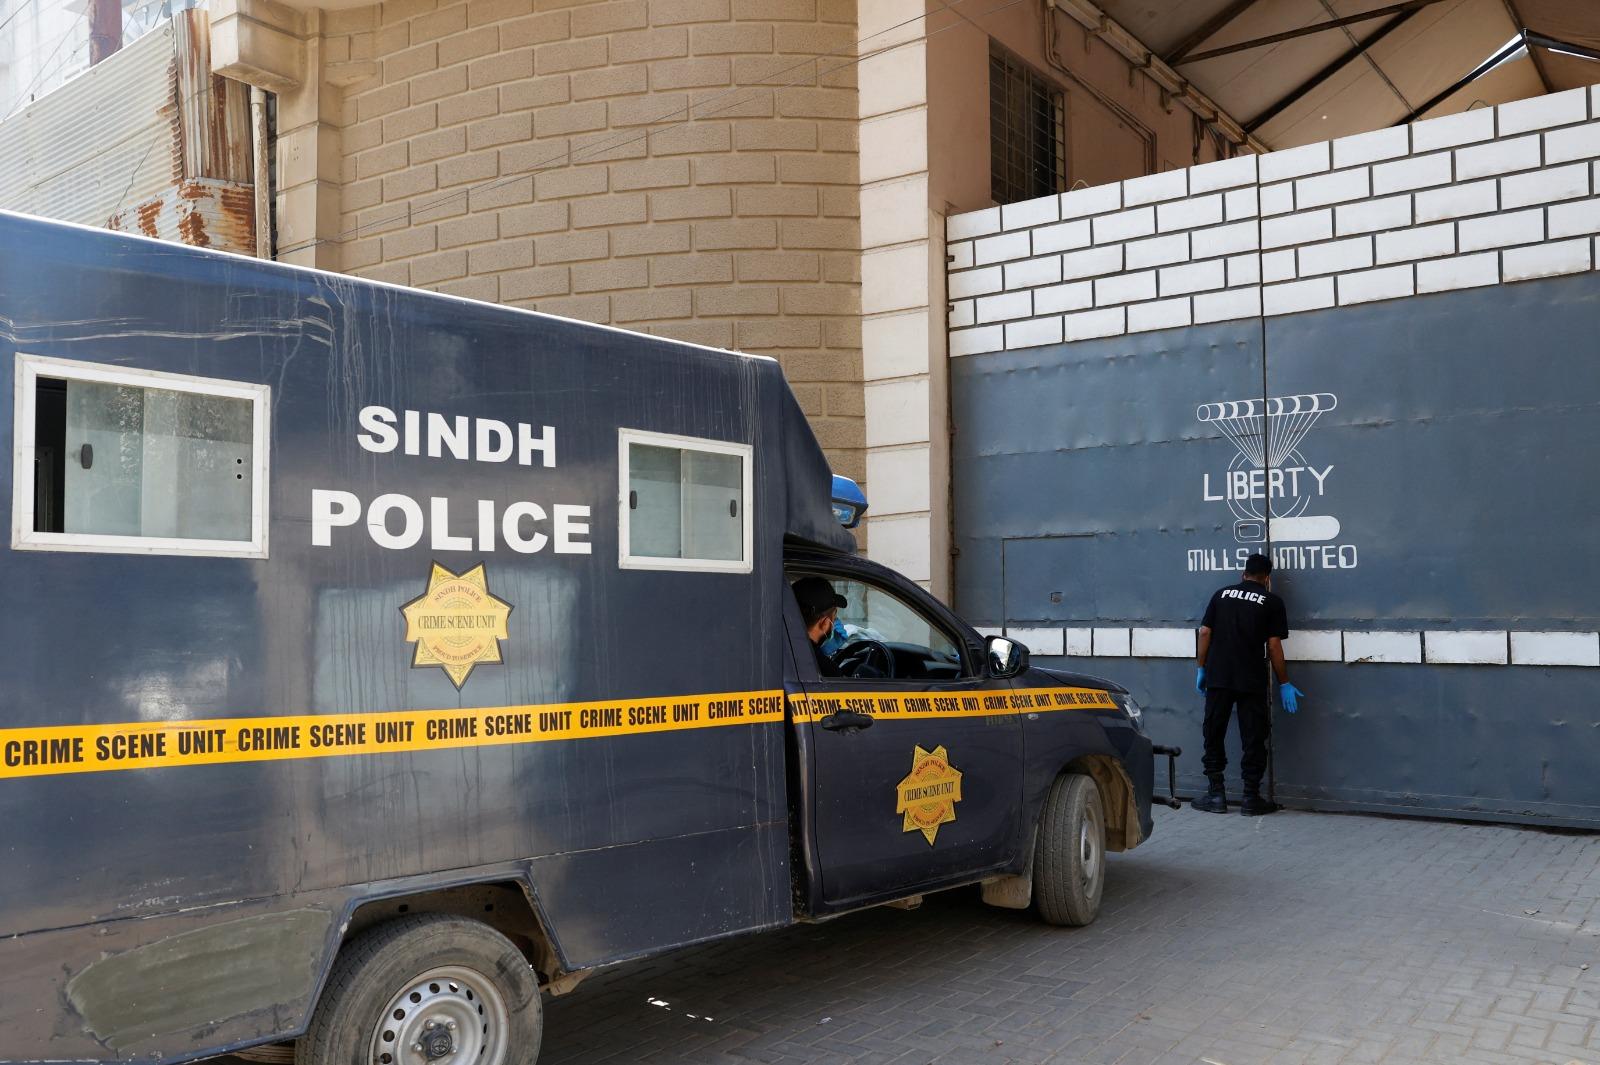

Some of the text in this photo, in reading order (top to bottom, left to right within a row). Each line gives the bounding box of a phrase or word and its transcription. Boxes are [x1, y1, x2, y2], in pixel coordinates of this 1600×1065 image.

[357, 406, 556, 467] SINDH
[1203, 464, 1334, 501] LIBERTY
[312, 489, 592, 554] POLICE
[1187, 544, 1358, 572] MILLS IMITED
[1221, 589, 1267, 605] POLICE
[418, 615, 496, 629] CRIME SCENE UNIT
[790, 699, 809, 717] NIT
[811, 698, 841, 715] CRIME
[845, 698, 876, 714] SCENE
[878, 698, 899, 713] UNIT
[903, 698, 933, 713] CRIME
[933, 697, 960, 712] SCENE
[961, 697, 980, 711] UNIT
[983, 696, 1008, 710] CRIME
[1009, 694, 1034, 709] SCENE
[1034, 694, 1052, 707] UNIT
[1054, 693, 1077, 706] CRIME
[1075, 693, 1097, 704] SCENE
[4, 696, 782, 767] CRIME SCENE UNIT CRIME SCENE UNIT CRIME SCENE UNIT CRIME SCENE UNIT CRIME SCENE
[904, 782, 954, 801] CRIME SCENE UNIT
